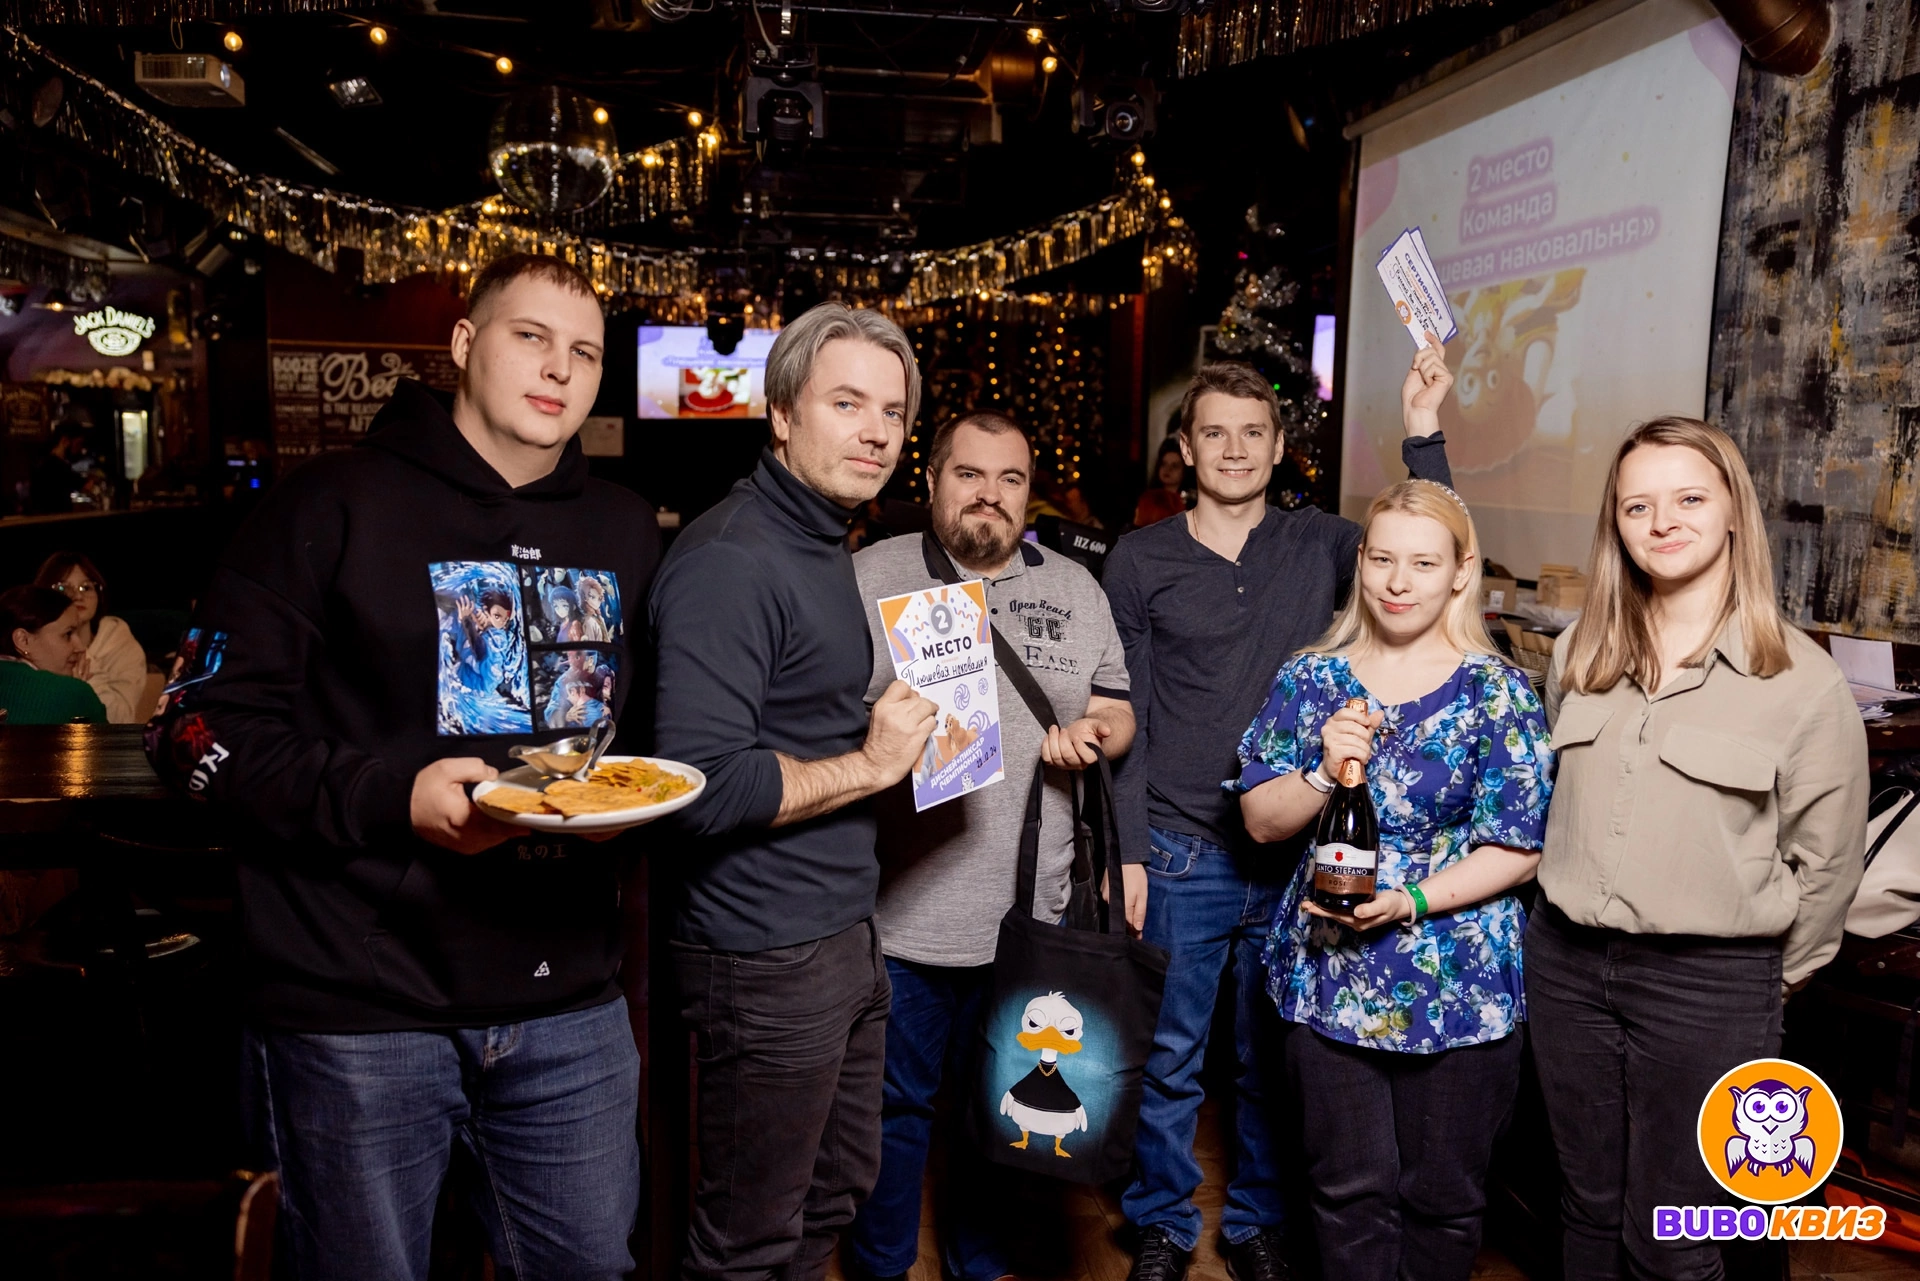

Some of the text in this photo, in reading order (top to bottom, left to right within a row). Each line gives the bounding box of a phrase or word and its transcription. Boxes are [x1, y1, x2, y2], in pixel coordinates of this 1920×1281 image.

[1470, 145, 1550, 192] 2 место
[1462, 191, 1552, 238] Команда
[1500, 216, 1655, 272] наковальня»
[1404, 252, 1443, 320] СЕРТИФИКАТ
[73, 310, 105, 335] JACK
[320, 352, 400, 401] Bee
[1073, 535, 1107, 554] HZ 600
[935, 609, 949, 629] 2
[1009, 599, 1072, 620] Open Beach
[921, 636, 972, 660] МЕСТО
[901, 659, 950, 687] Плюшевая
[1335, 866, 1368, 876] STEFANO
